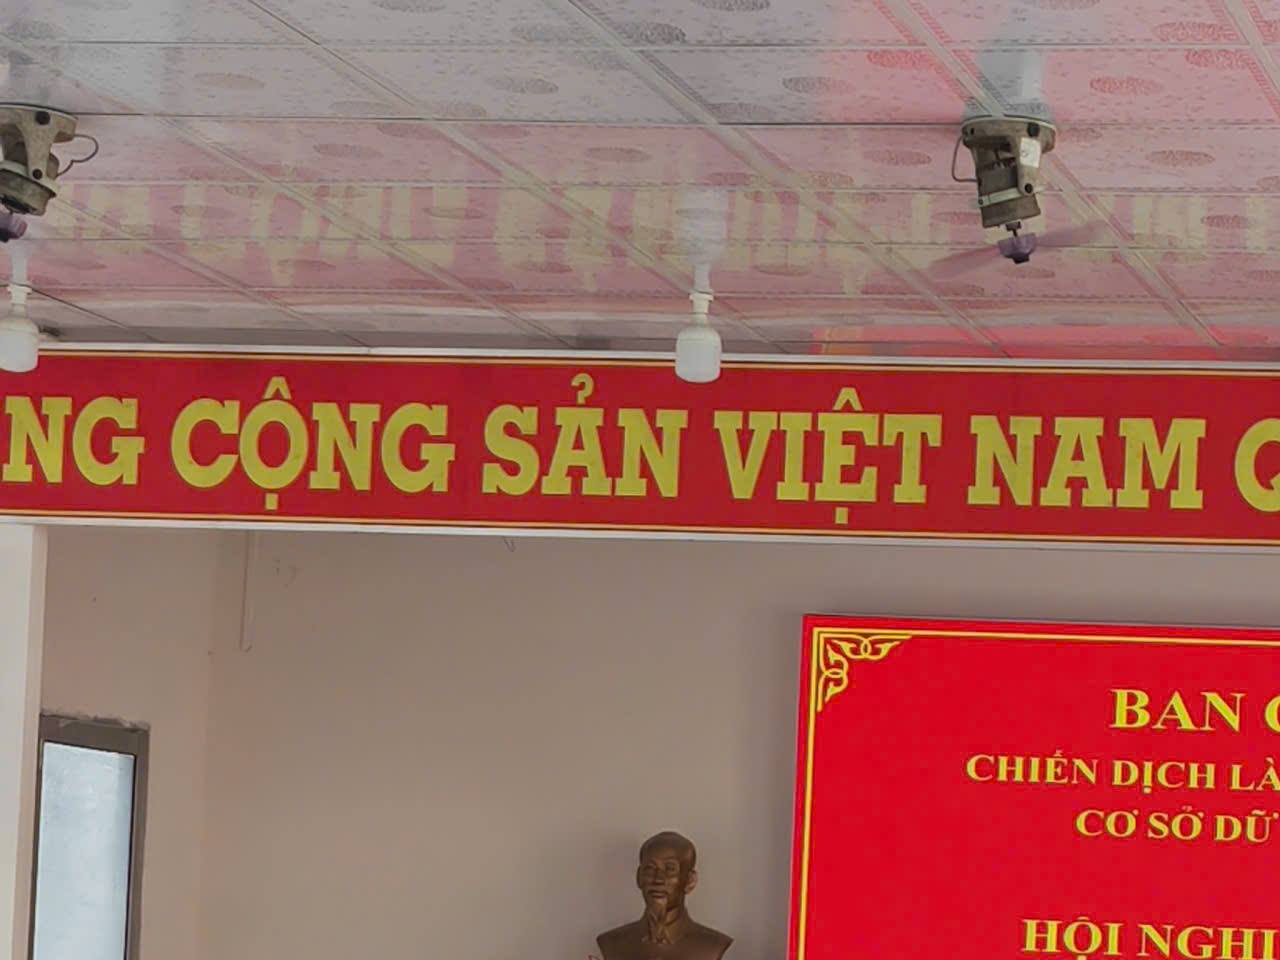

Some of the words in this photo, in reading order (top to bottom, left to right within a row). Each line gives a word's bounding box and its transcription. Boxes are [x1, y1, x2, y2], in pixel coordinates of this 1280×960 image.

[170, 377, 455, 511] CỘNG
[481, 373, 689, 498] SẢN
[713, 387, 942, 525] VIỆT
[967, 415, 1206, 510] NAM
[1110, 687, 1243, 734] BAN
[966, 749, 1097, 786] CHIẾN
[1111, 758, 1216, 795] DỊCH
[1075, 809, 1138, 840] CƠ
[1147, 805, 1206, 841] SỞ
[1214, 808, 1280, 844] DỮ
